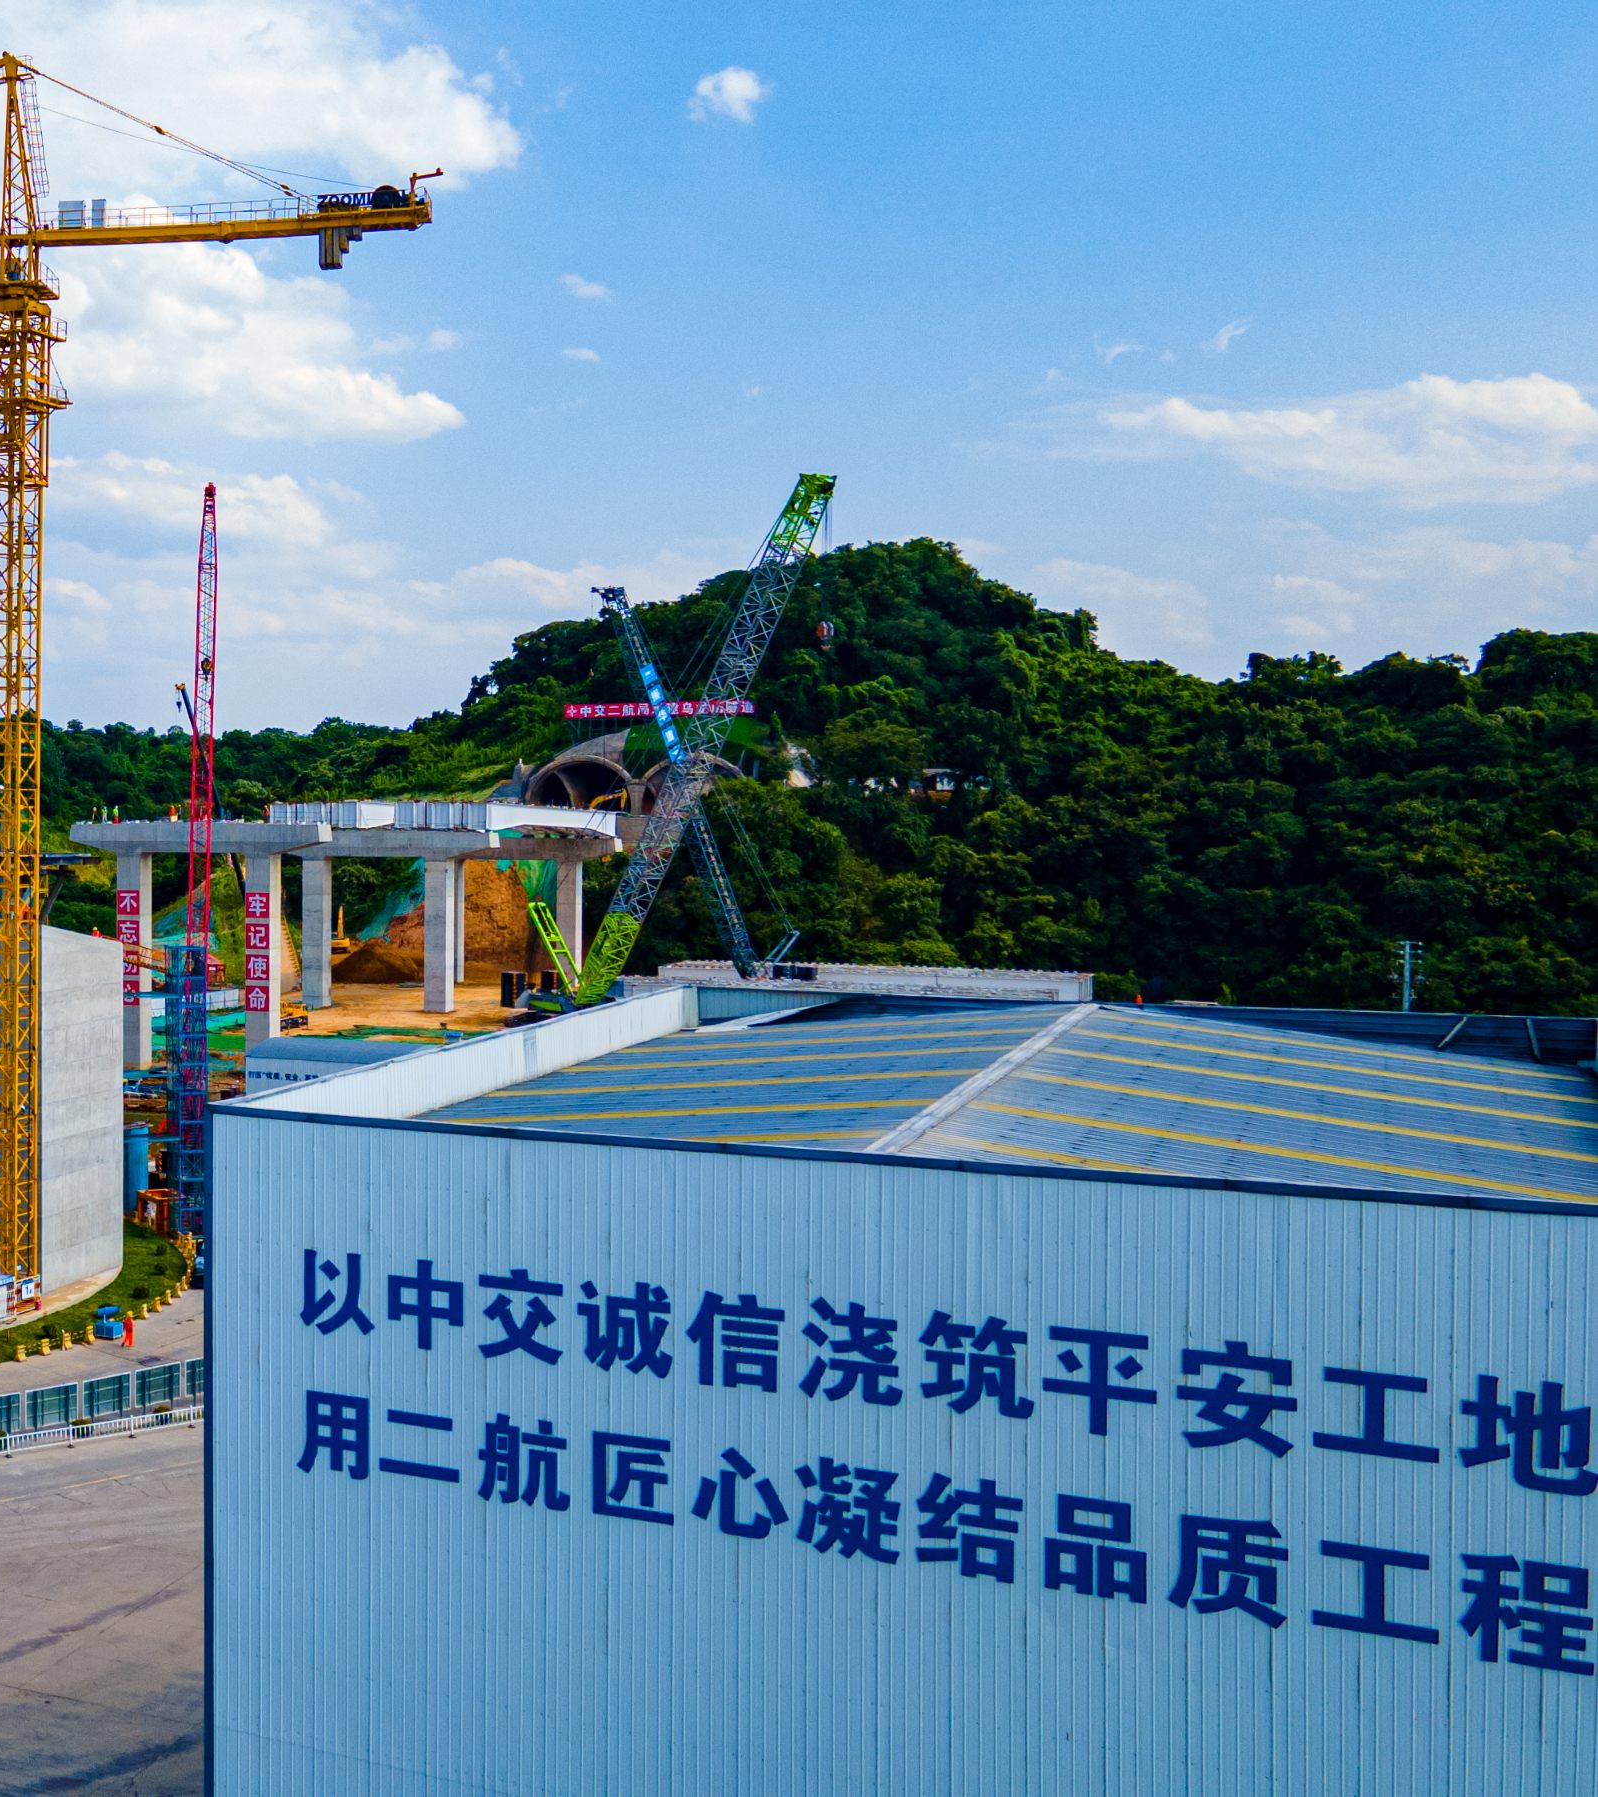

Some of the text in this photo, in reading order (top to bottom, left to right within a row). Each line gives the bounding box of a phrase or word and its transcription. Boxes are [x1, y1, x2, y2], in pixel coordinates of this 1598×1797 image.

[248, 894, 267, 1010] 牢记使命
[300, 1249, 1598, 1497] 以中交诚信浇筑平安工地
[297, 1390, 1595, 1677] 用二航匠心凝结品质工程
